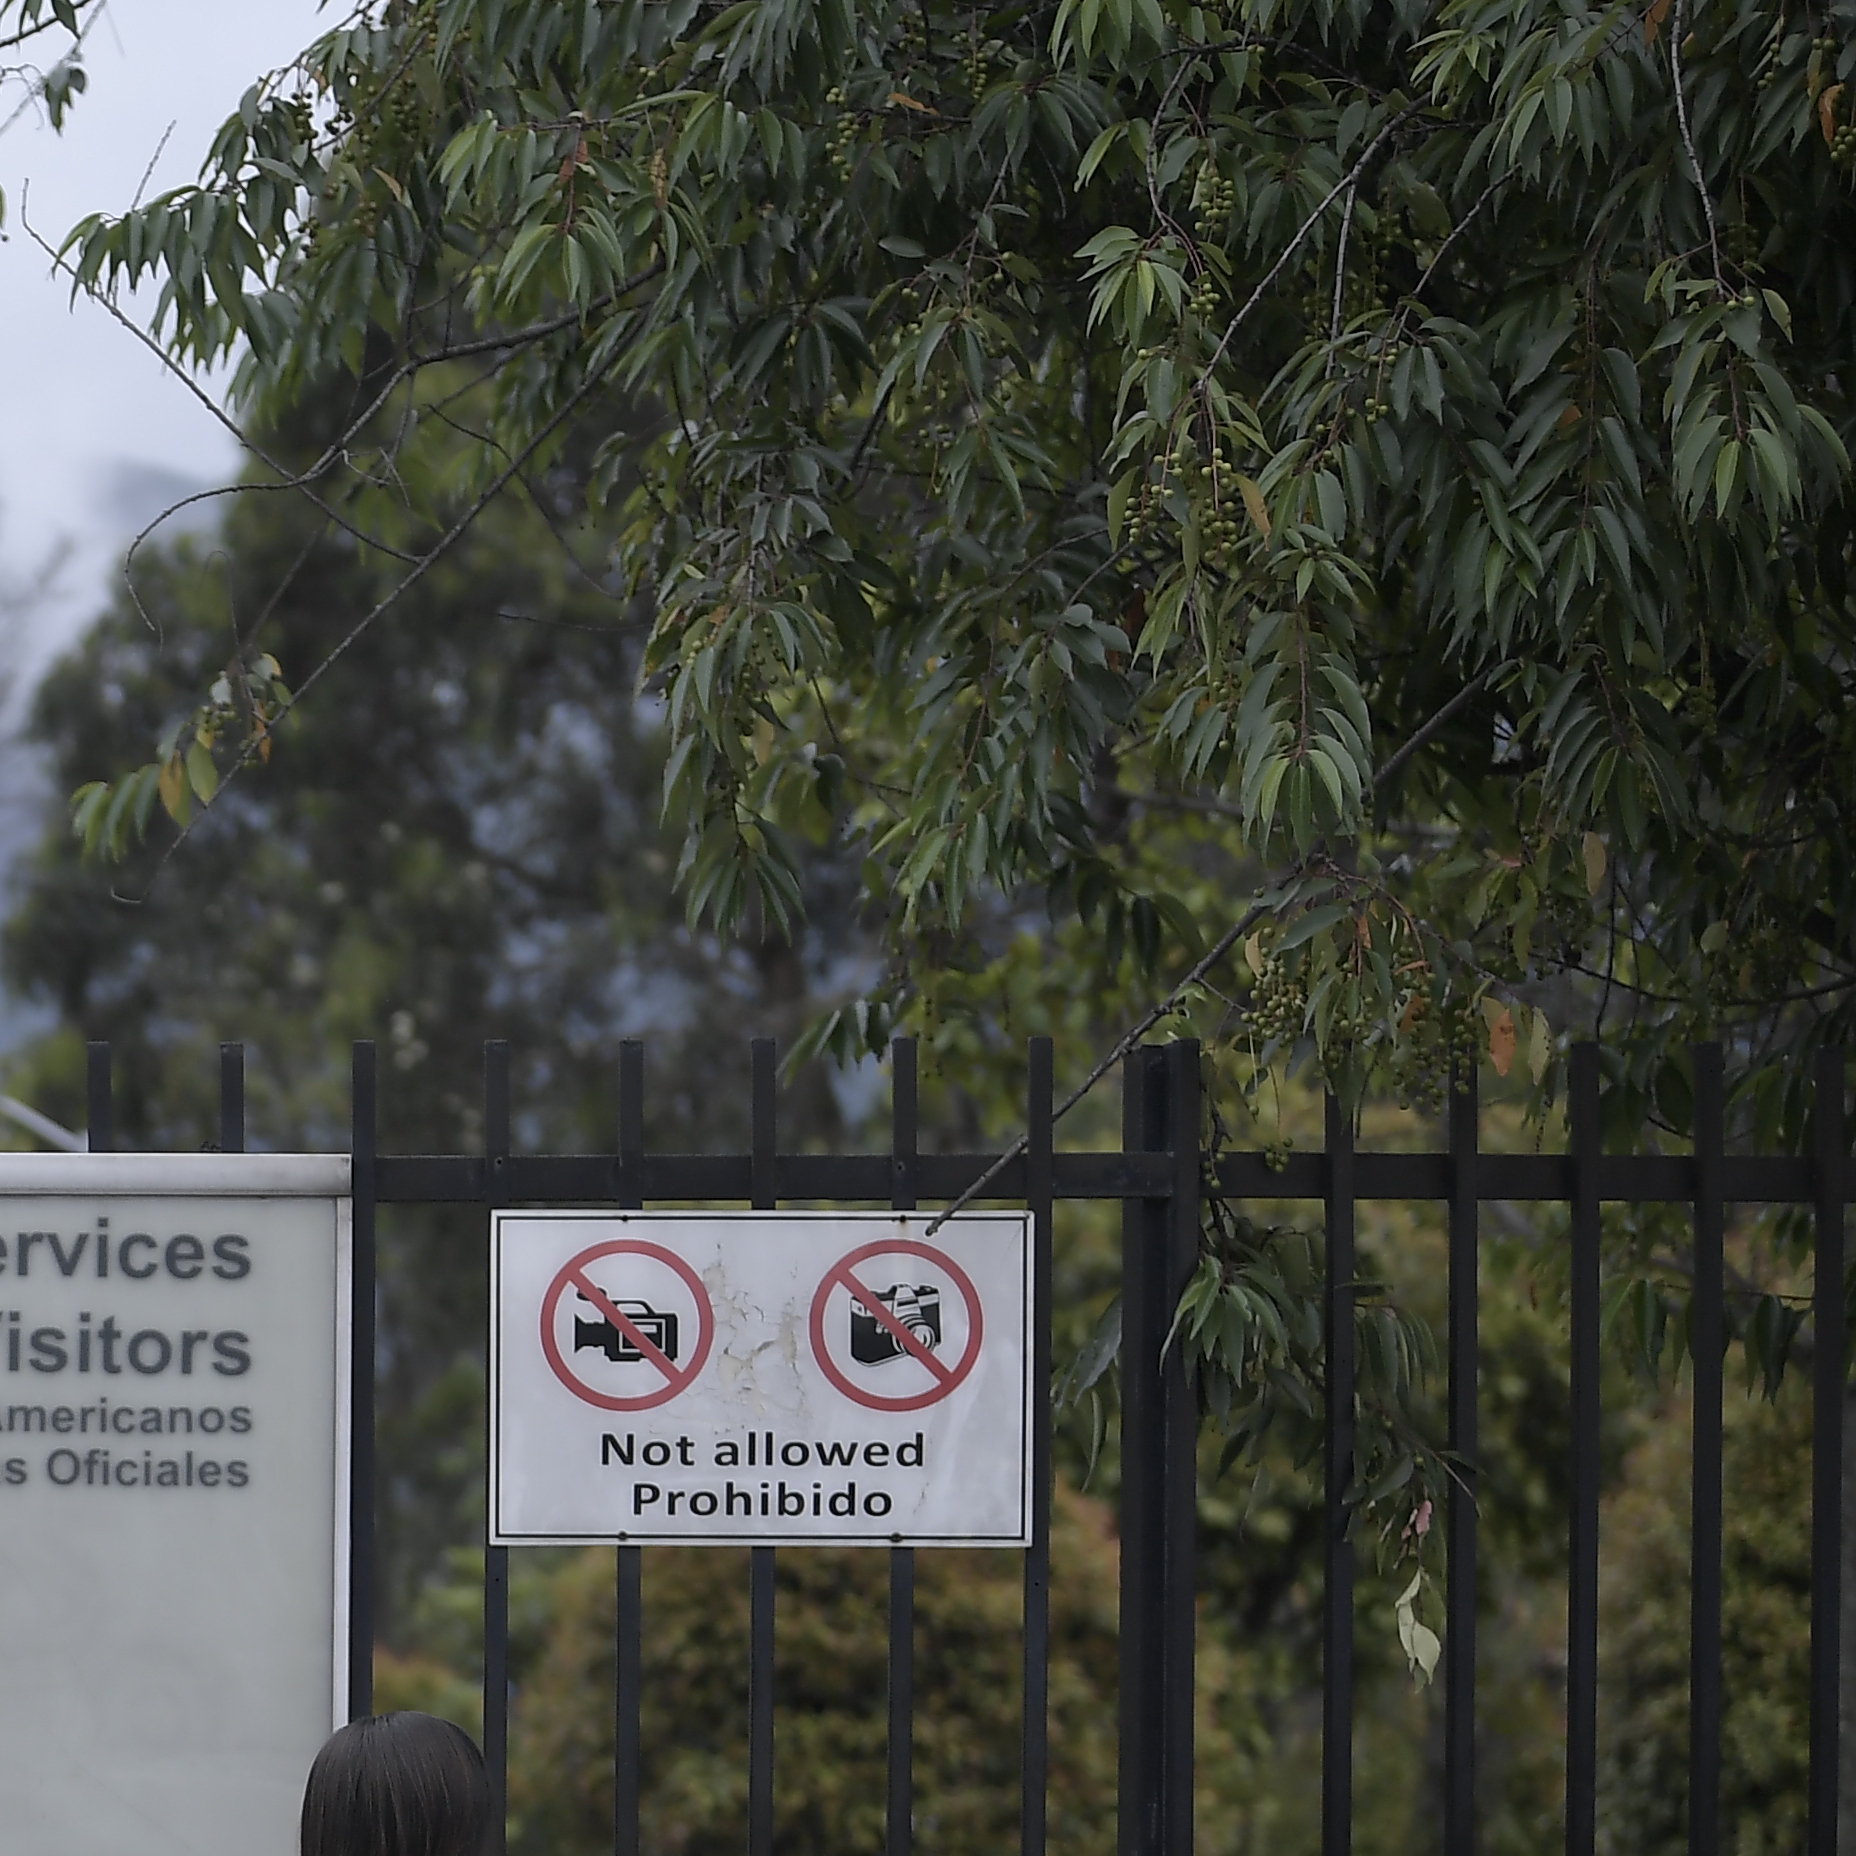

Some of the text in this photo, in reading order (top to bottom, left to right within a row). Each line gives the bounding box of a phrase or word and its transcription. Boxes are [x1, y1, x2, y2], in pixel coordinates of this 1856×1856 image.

[601, 1431, 924, 1467] Not allowed
[46, 1448, 250, 1489] Oficiales
[633, 1481, 892, 1517] Prohibido
